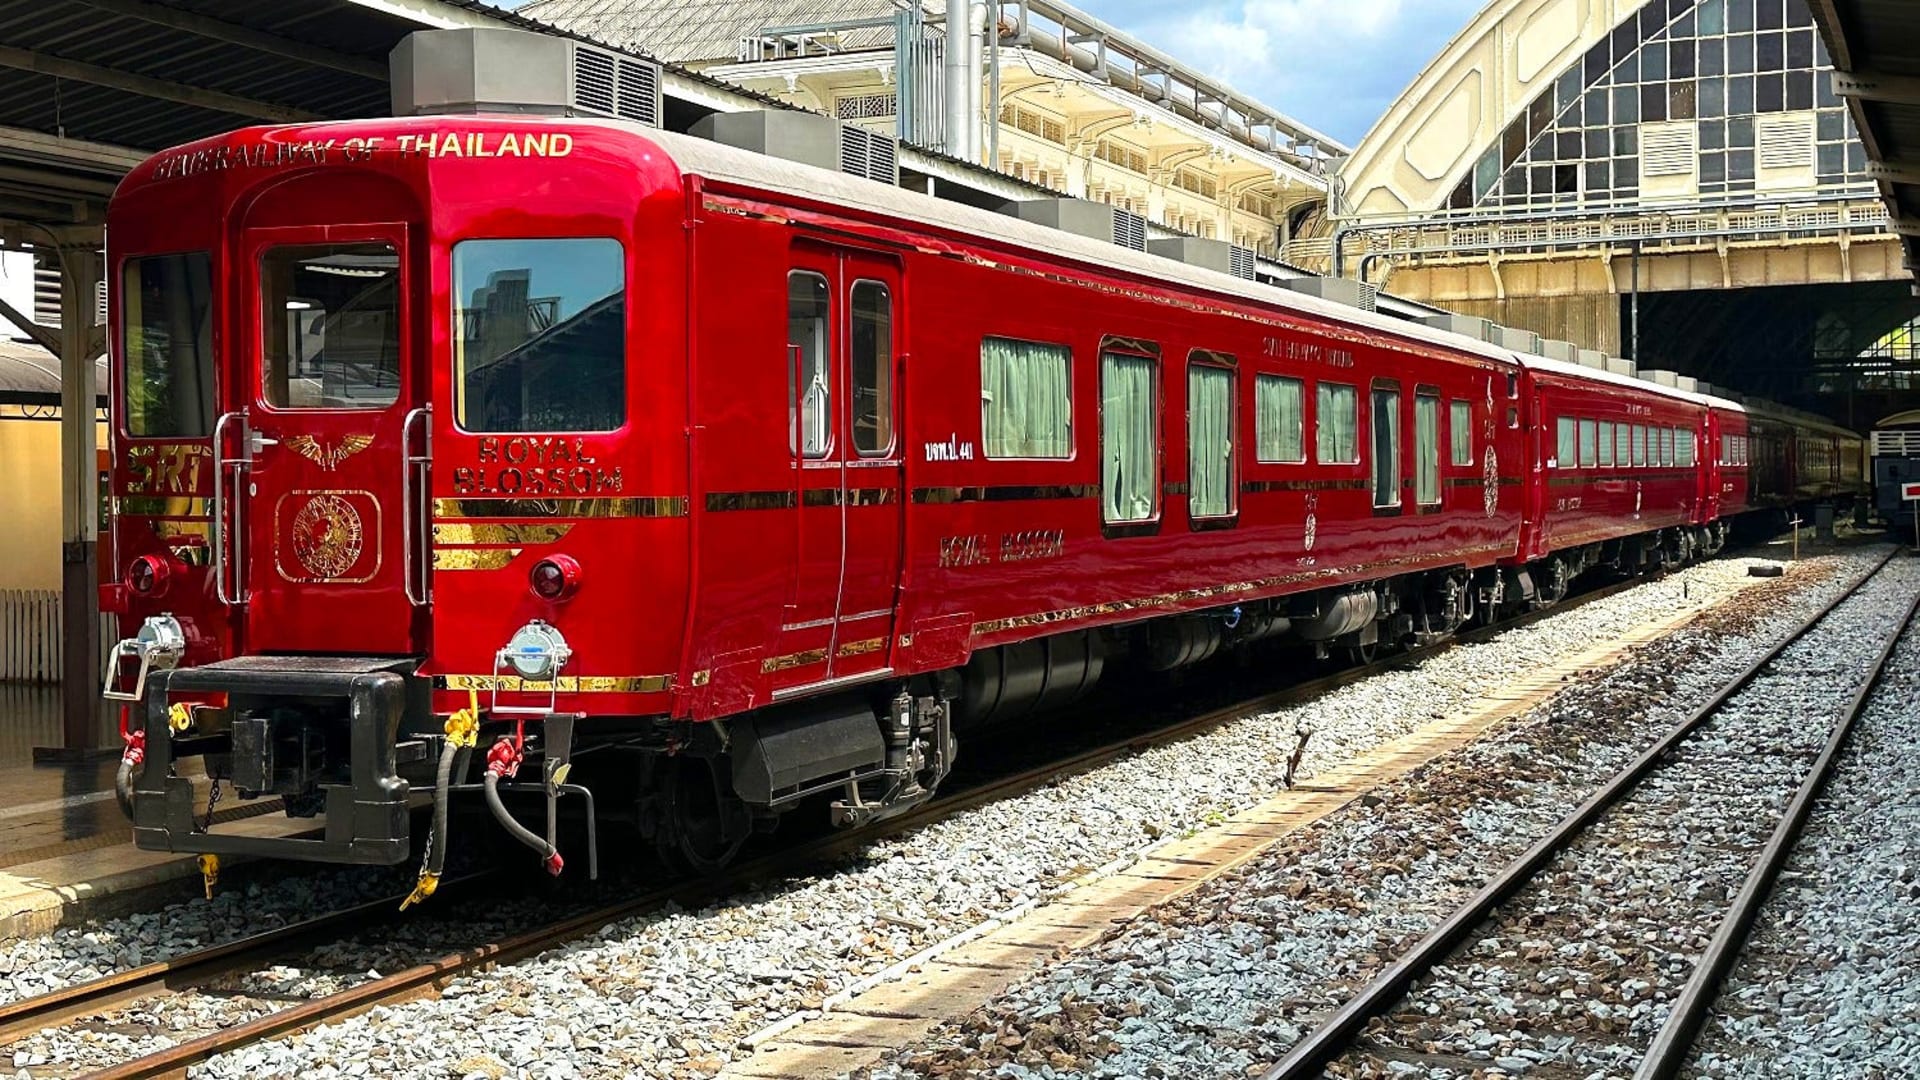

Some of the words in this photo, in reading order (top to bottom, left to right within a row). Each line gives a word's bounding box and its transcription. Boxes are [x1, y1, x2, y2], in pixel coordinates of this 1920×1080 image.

[215, 137, 337, 169] RAILWAY
[343, 137, 385, 161] OF
[396, 132, 573, 158] THAILAND
[478, 436, 596, 464] ROYAL
[960, 442, 974, 460] 441
[127, 444, 213, 493] SRT
[453, 466, 623, 494] BLOSSOM
[938, 534, 991, 568] ROYAL
[999, 528, 1064, 562] BLOSSOM
